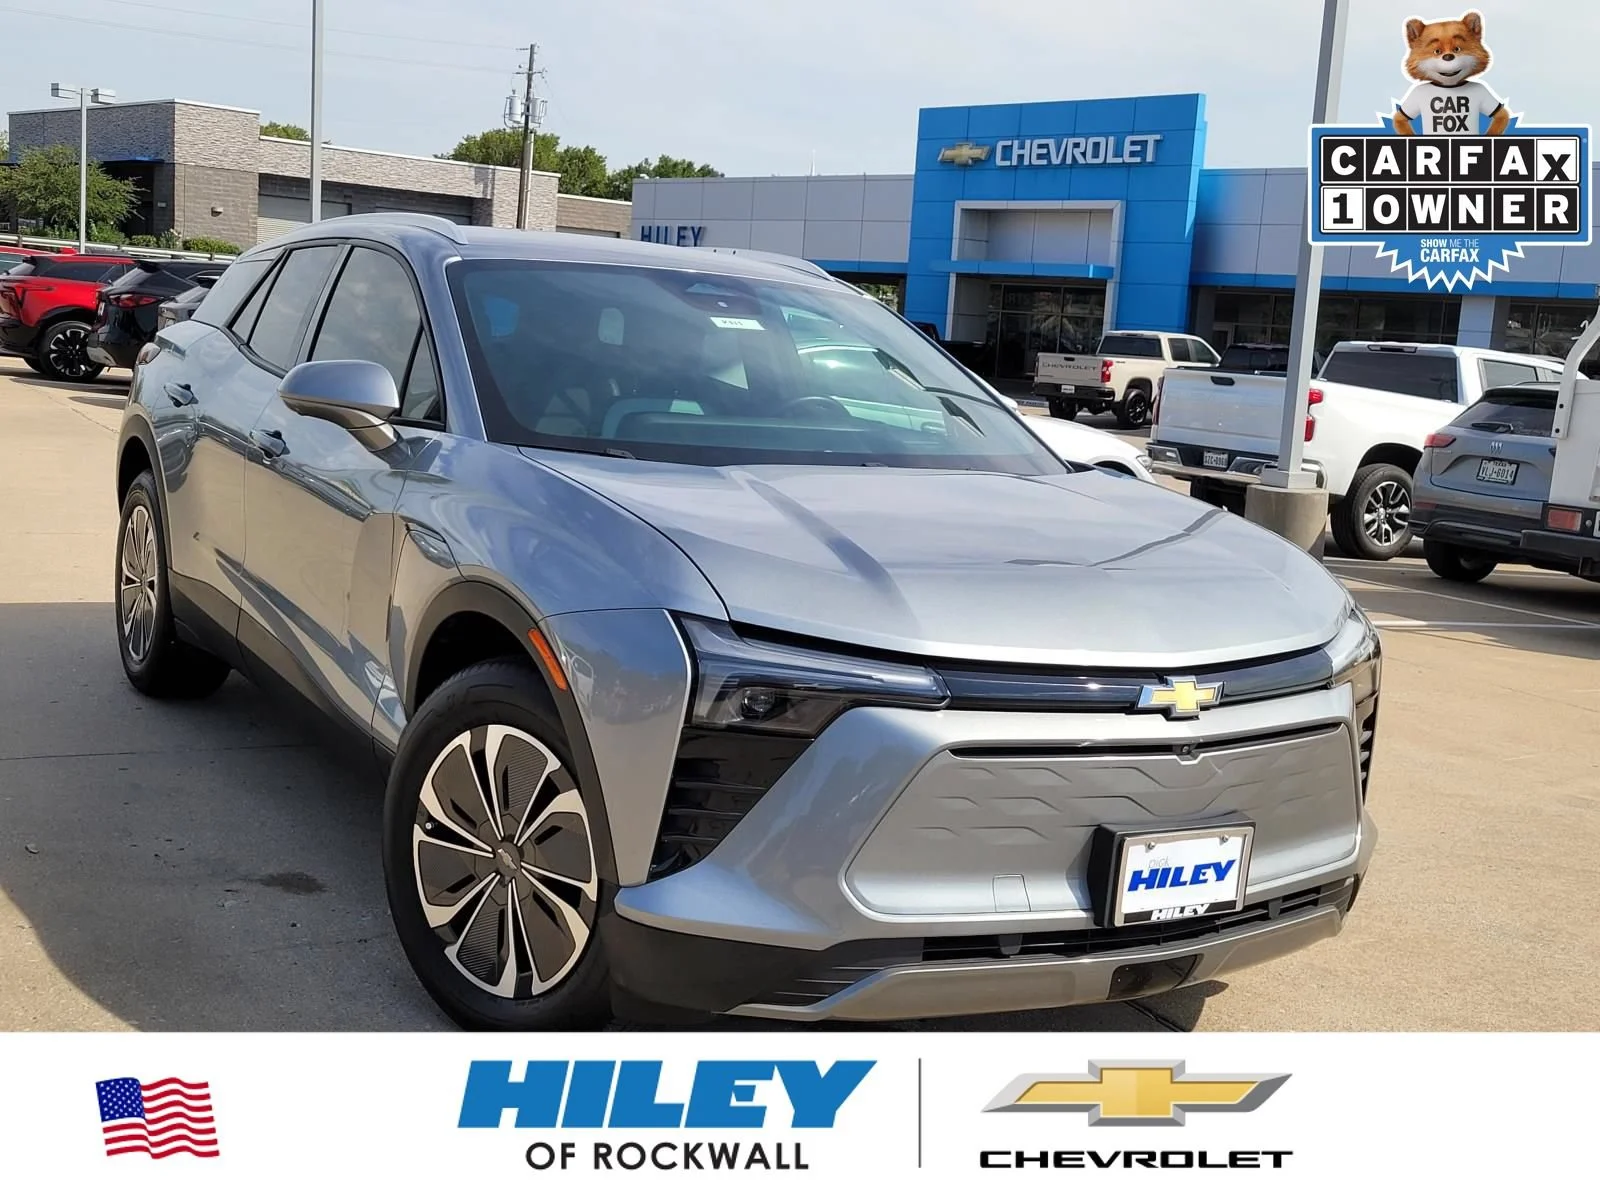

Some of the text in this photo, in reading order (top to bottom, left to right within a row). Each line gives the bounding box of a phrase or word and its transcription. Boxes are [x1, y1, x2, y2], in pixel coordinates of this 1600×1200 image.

[995, 134, 1163, 167] CHEVROLET
[641, 225, 704, 247] HILEY
[1041, 361, 1098, 371] CHEVROLET
[1128, 859, 1237, 892] HILEY
[1151, 903, 1210, 921] HILEY
